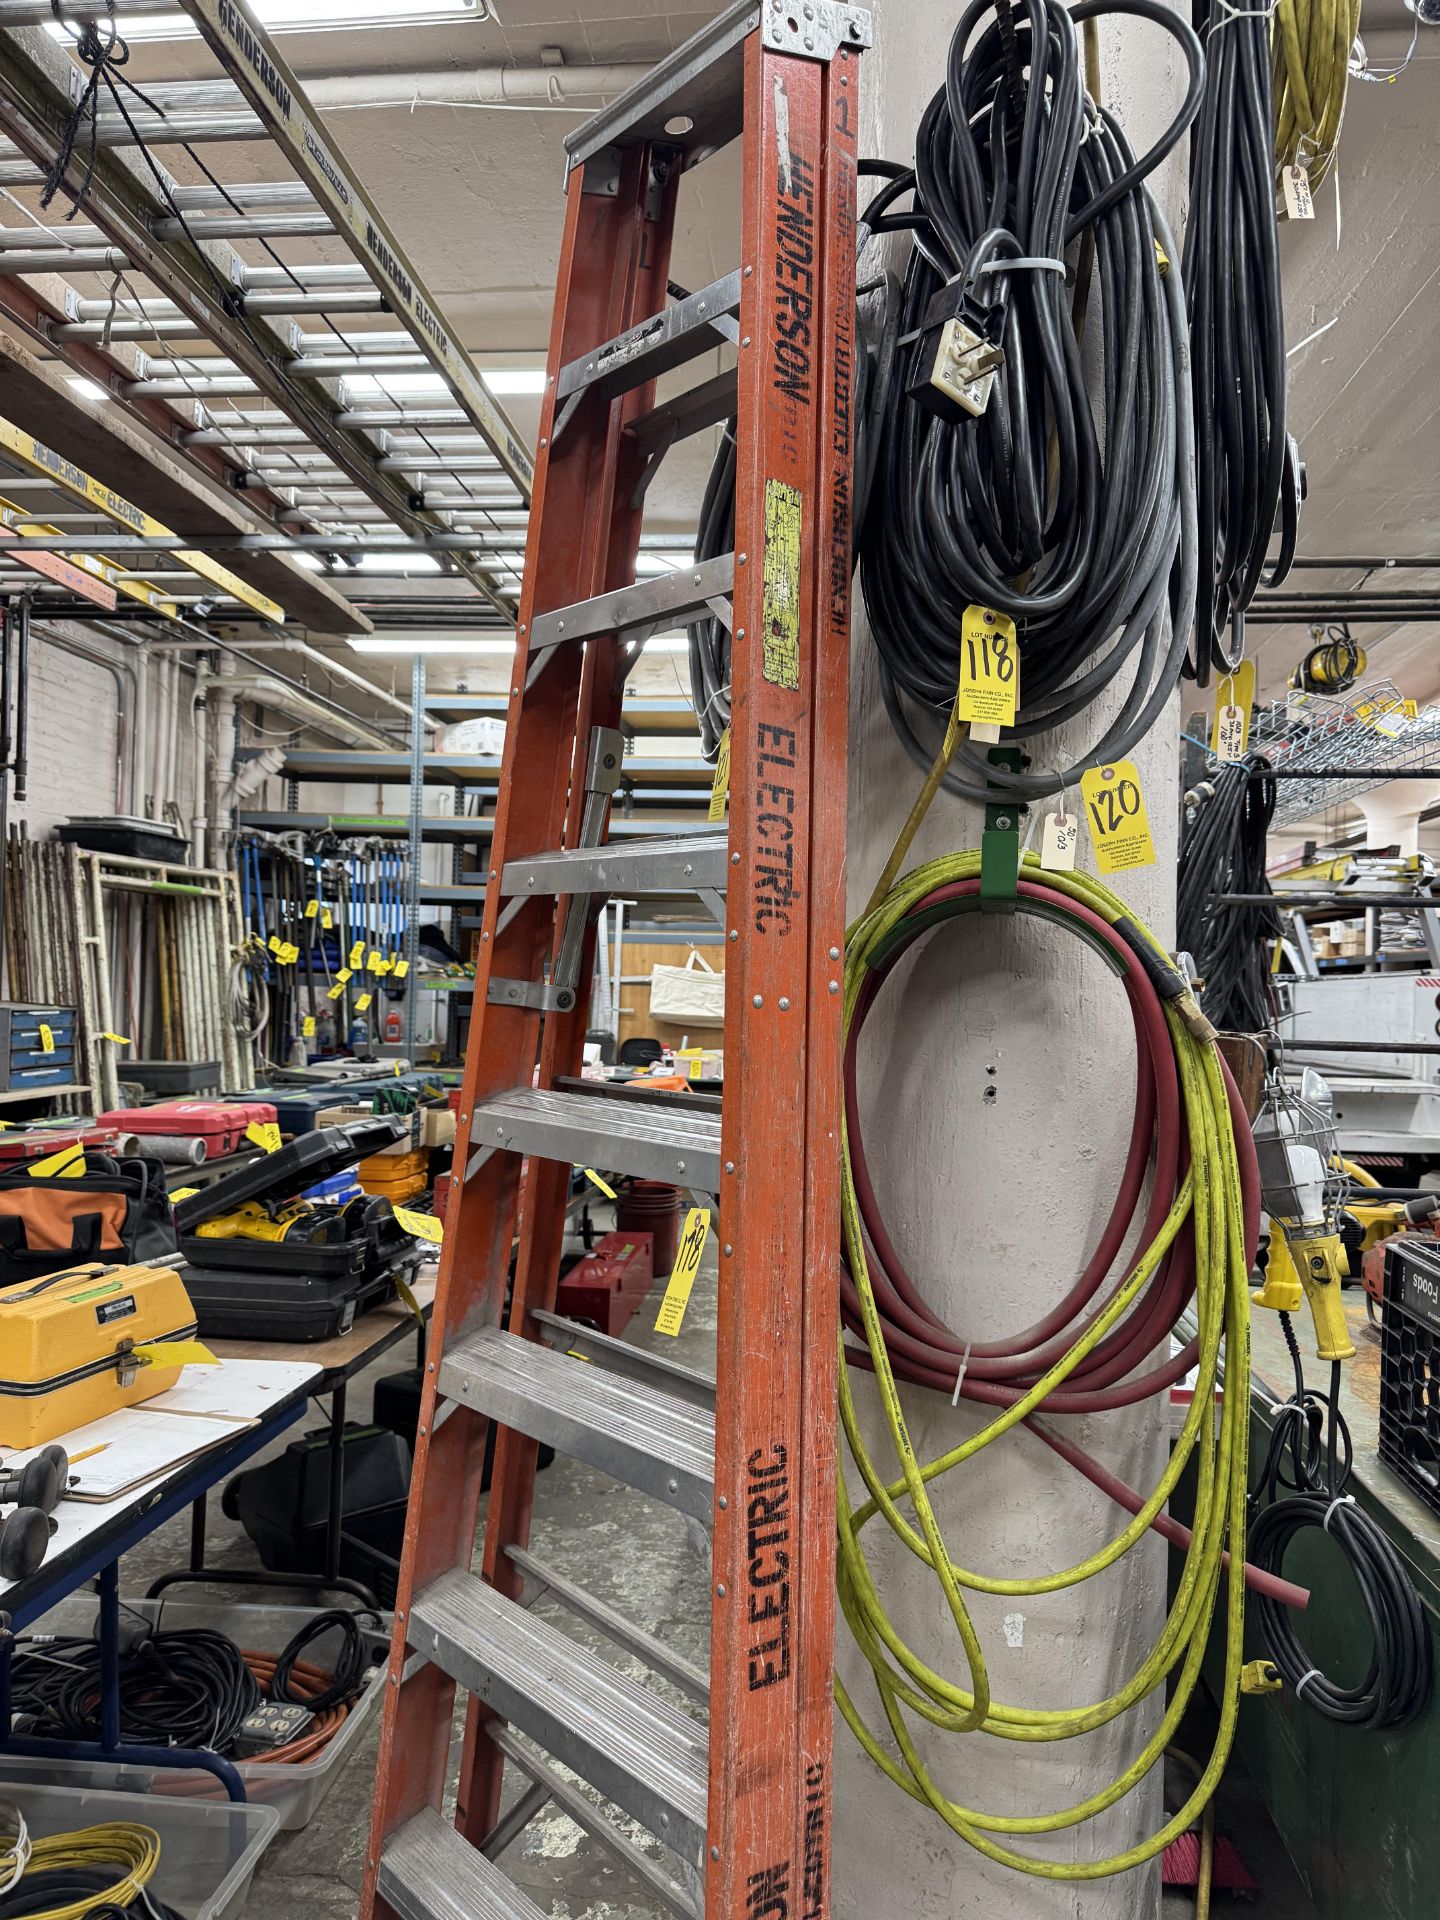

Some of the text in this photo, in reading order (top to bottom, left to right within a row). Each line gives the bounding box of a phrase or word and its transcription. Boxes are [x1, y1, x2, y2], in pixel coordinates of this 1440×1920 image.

[366, 221, 448, 357] HENDERSON ELECTRIC
[967, 632, 1013, 683] 118
[971, 631, 983, 639] LOT
[754, 722, 796, 937] ELECTRIC
[1089, 780, 1140, 835] 120
[1412, 1273, 1439, 1305] Foods
[748, 1444, 790, 1692] ELECTRIC
